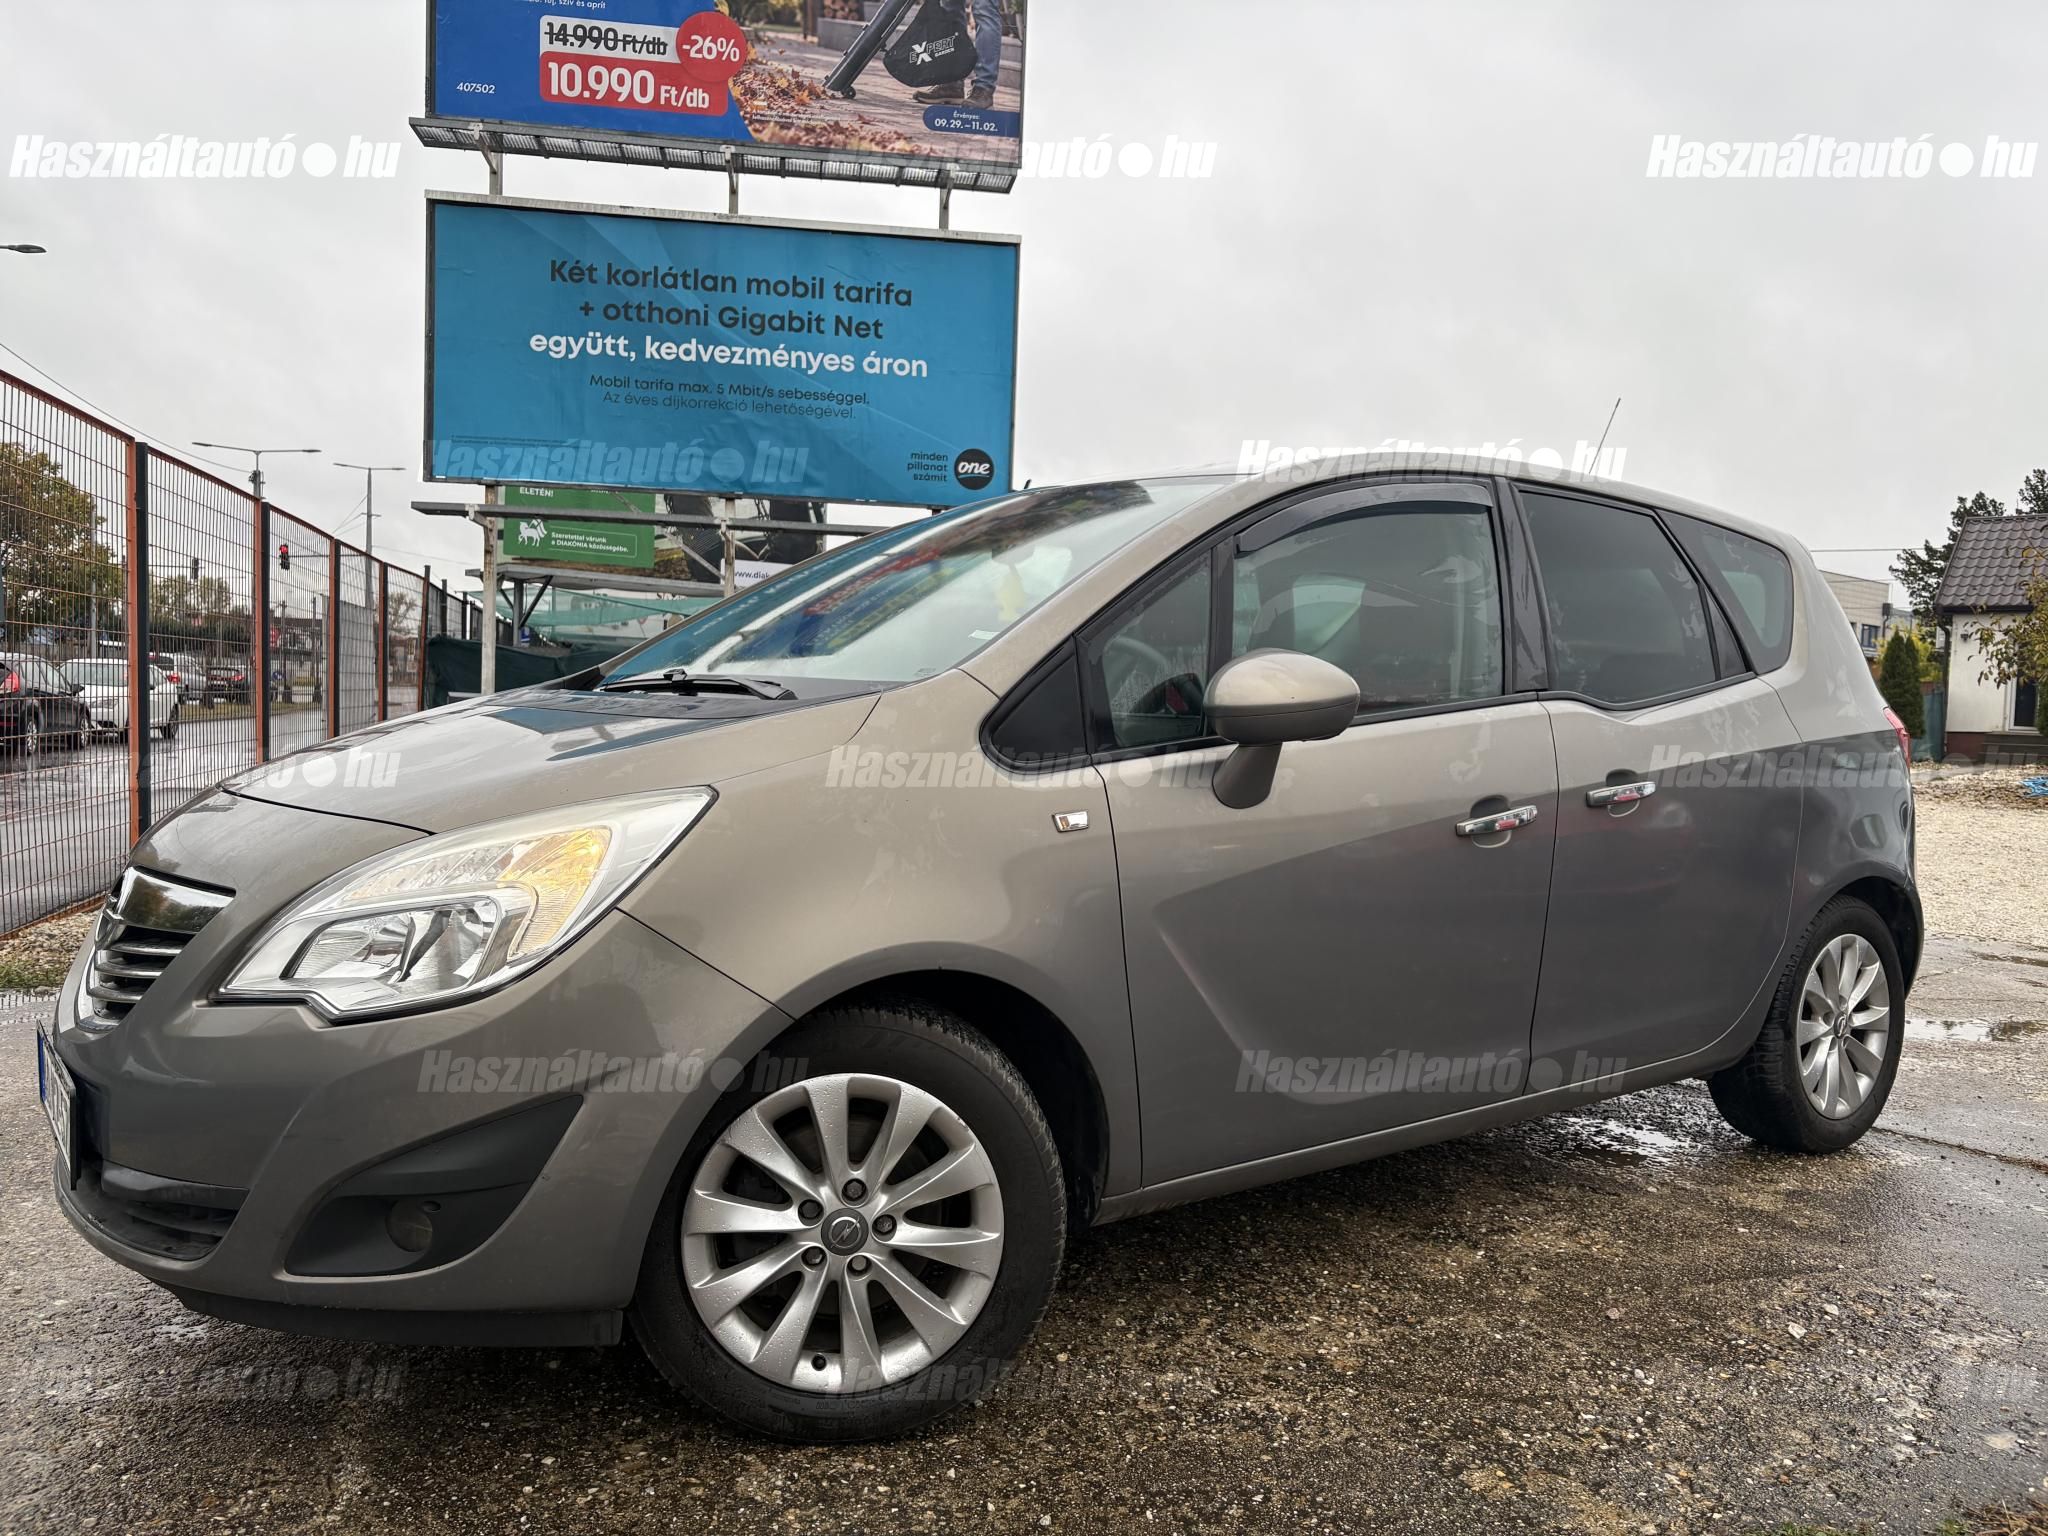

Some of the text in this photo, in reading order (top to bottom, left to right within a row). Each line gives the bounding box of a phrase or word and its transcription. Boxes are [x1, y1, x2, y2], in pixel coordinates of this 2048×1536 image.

[544, 22, 668, 56] 14.990 Ft/db
[682, 35, 740, 62] -26%
[456, 82, 495, 94] 407502
[548, 62, 710, 109] 10.990 Ft/db
[550, 259, 912, 307] Két korlátlan mobil tarifa
[579, 300, 883, 339] + otthoni Gigabit Net
[530, 331, 928, 378] együtt, kedvezményes áron
[589, 374, 870, 405] Mobil tarifa max. 5 Mbit/s sebességgel.
[603, 391, 621, 404] Az
[624, 393, 659, 406] éves
[752, 399, 857, 419] lehetőségével.
[907, 462, 947, 472] pillanat
[910, 451, 948, 462] minden
[958, 461, 991, 475] one
[913, 473, 948, 482] számít
